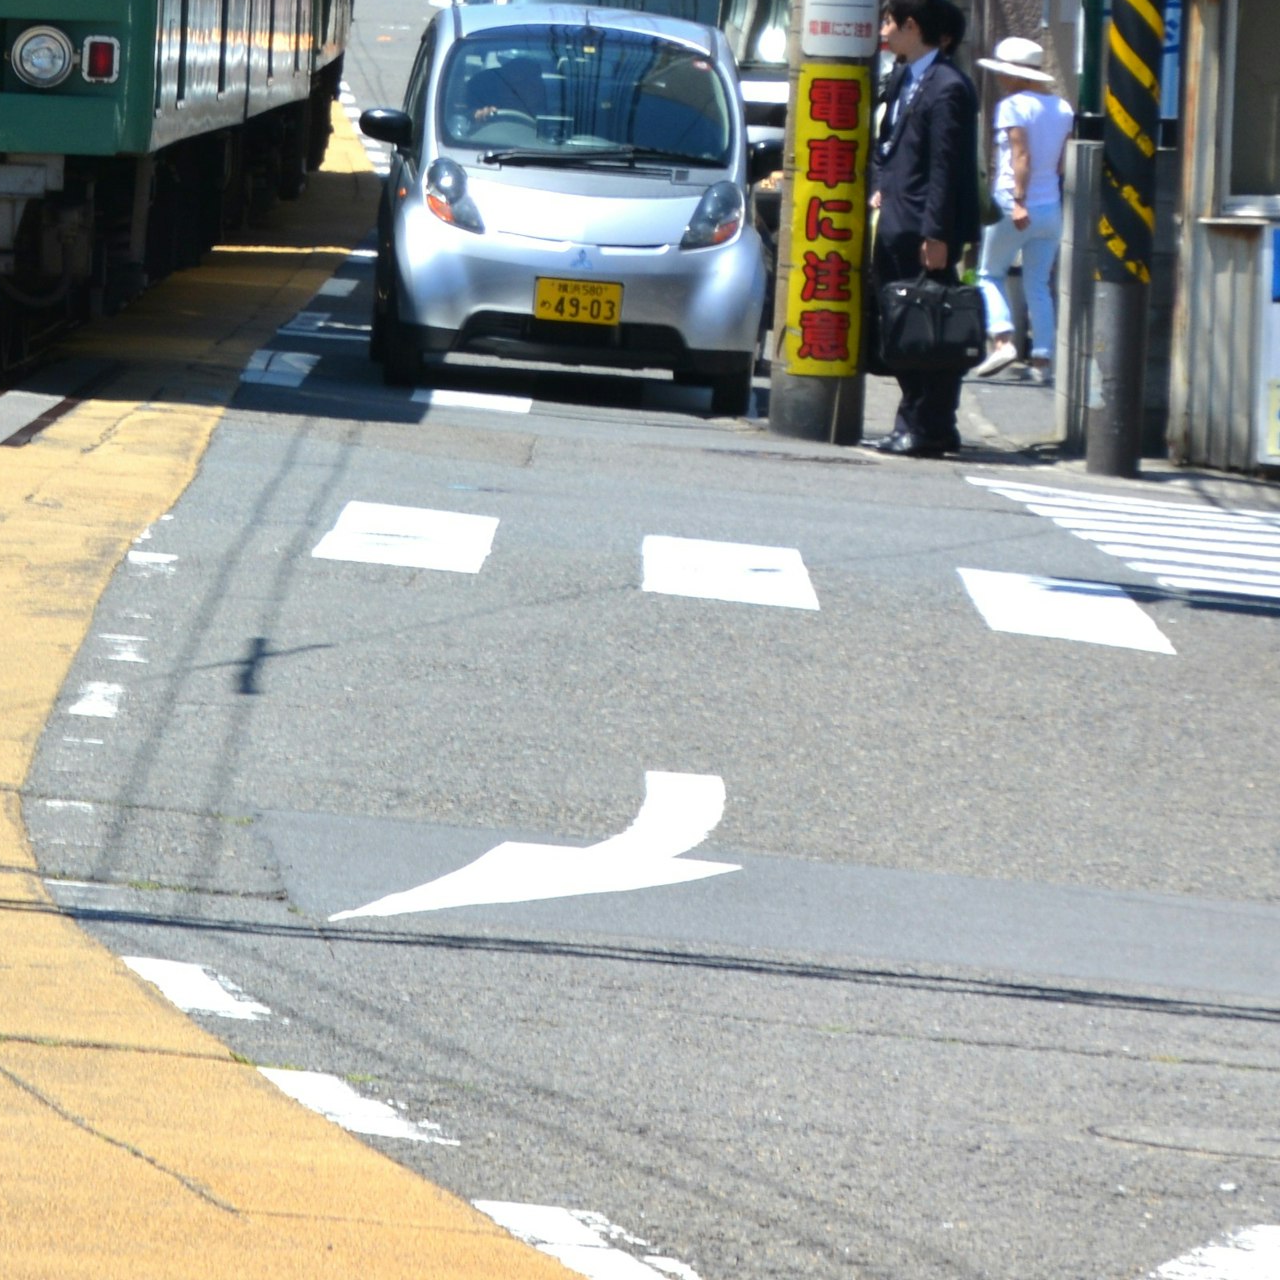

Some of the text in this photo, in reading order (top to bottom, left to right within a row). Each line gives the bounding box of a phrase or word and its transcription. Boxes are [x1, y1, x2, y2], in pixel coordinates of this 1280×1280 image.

[808, 20, 873, 38] 電車にご注意
[798, 77, 861, 361] 電車に注意
[554, 297, 616, 321] 49-03
